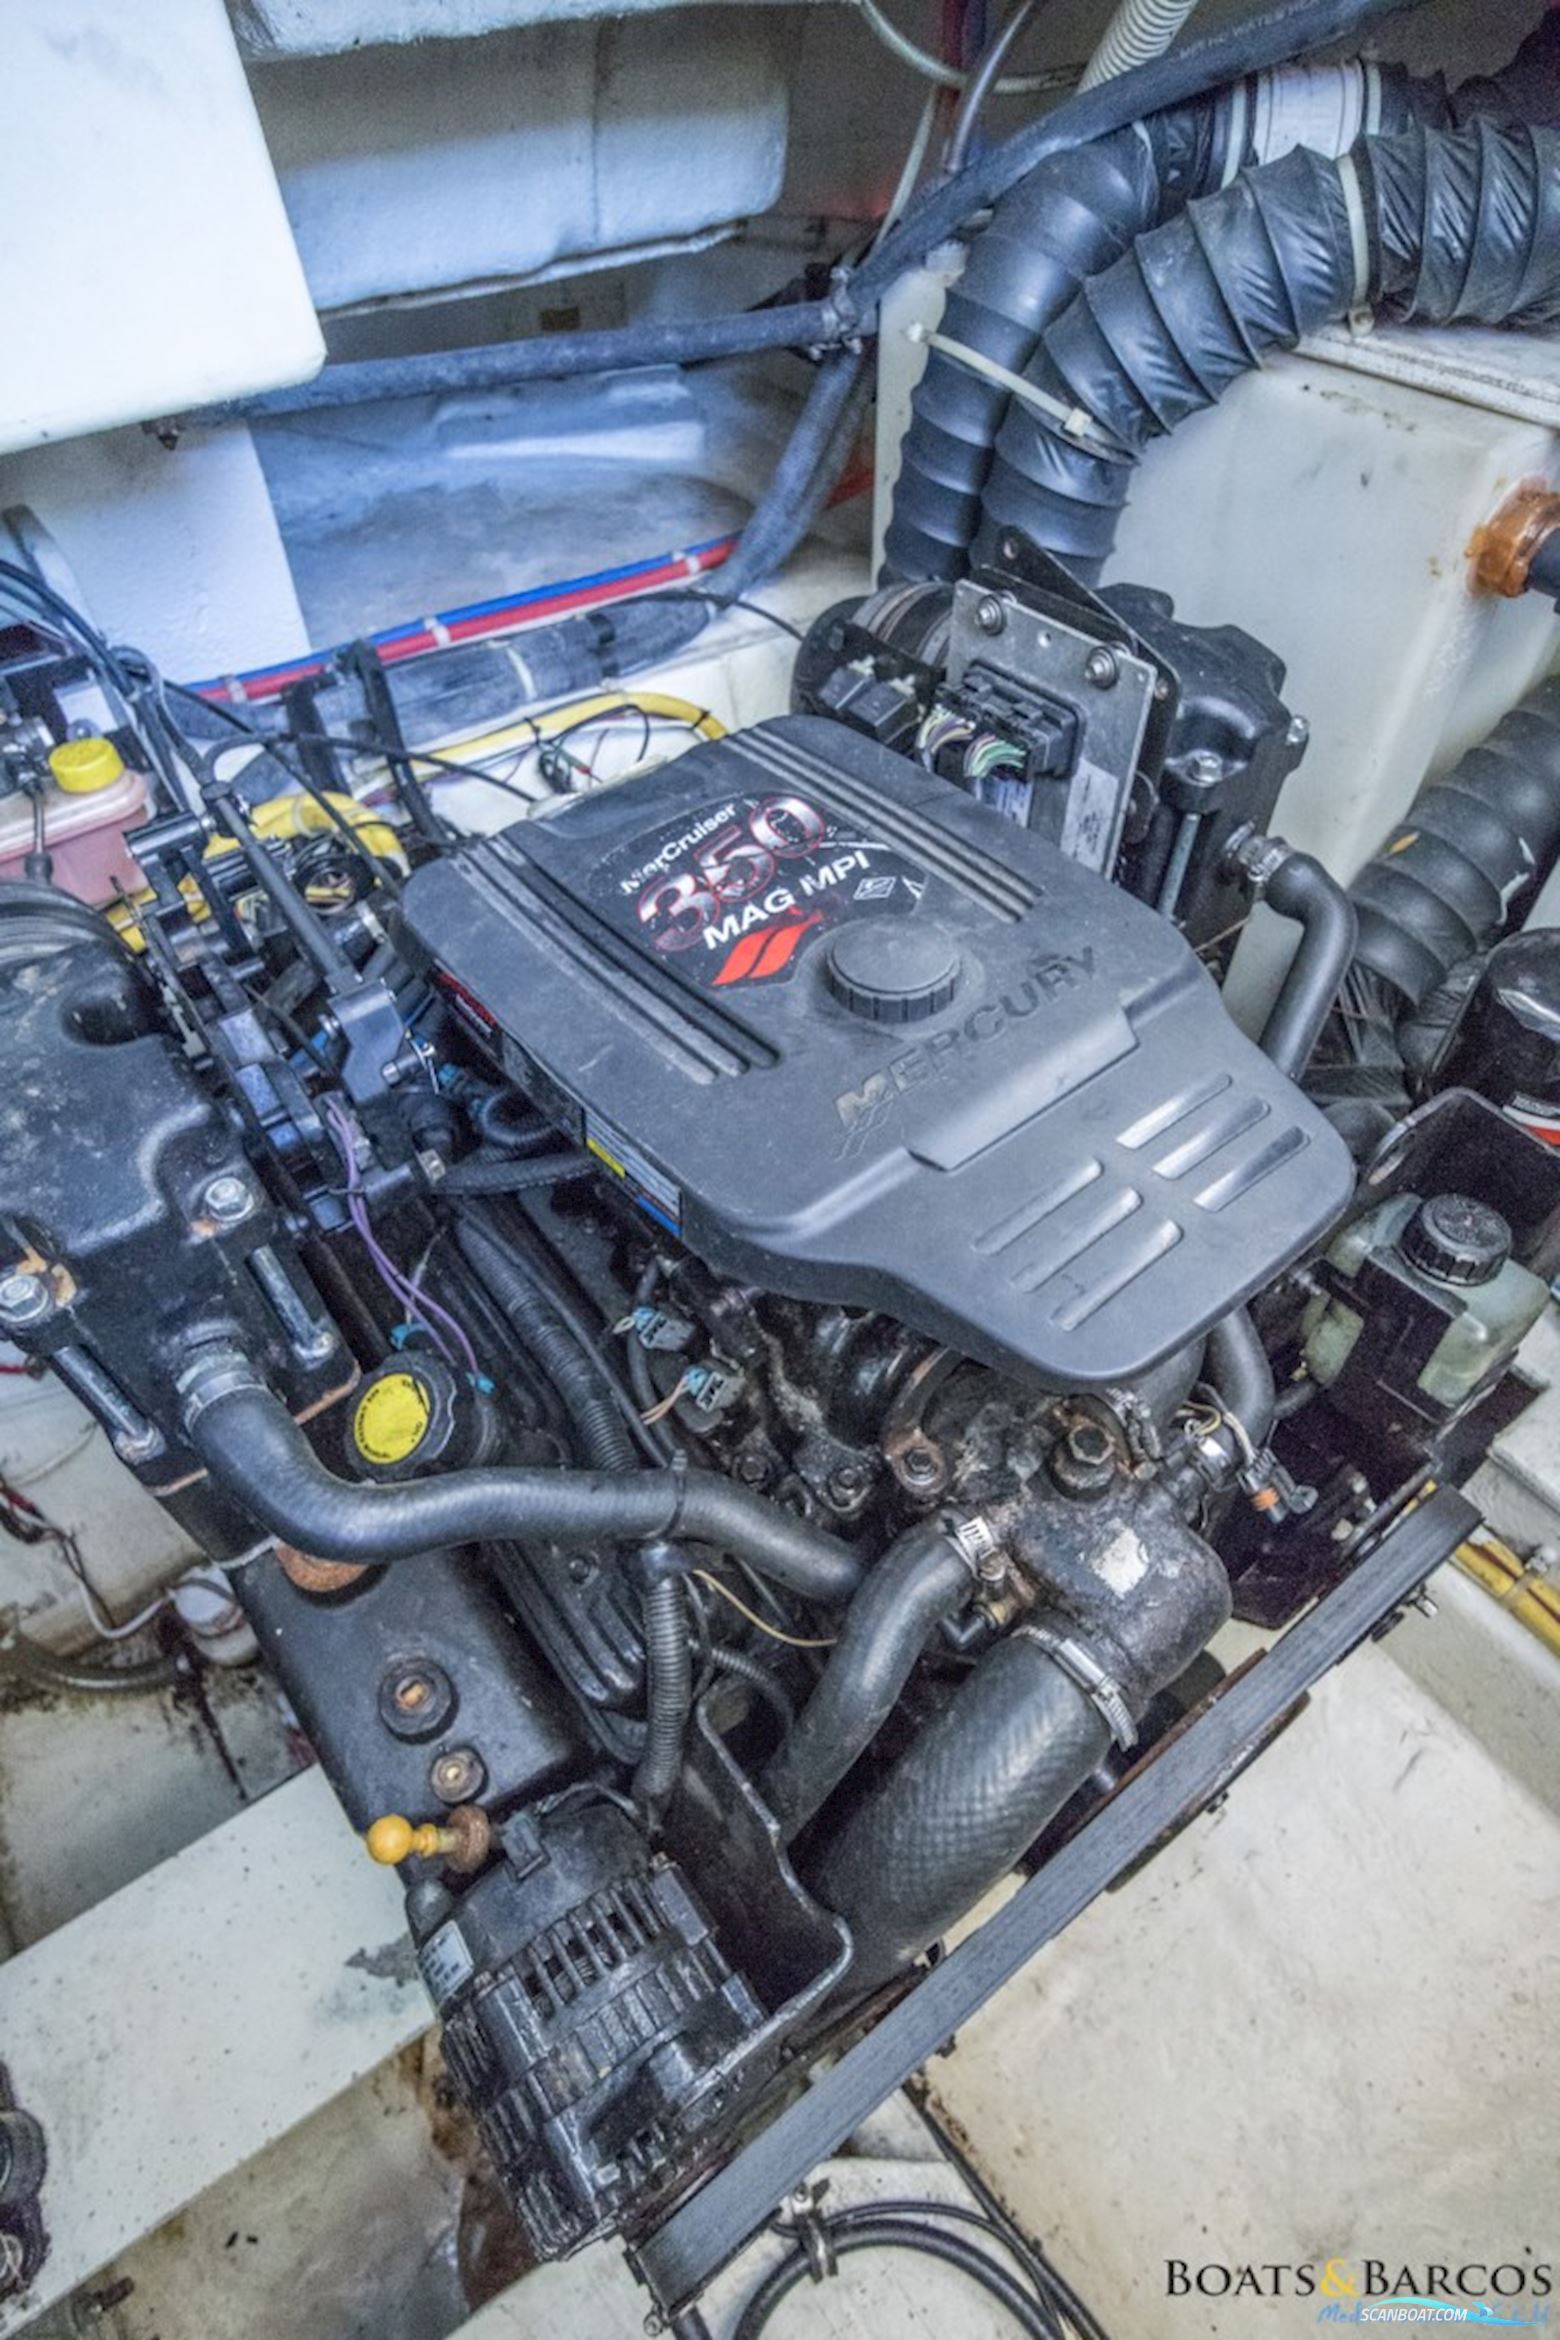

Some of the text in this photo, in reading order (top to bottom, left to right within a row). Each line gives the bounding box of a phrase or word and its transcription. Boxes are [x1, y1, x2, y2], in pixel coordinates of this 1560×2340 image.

[638, 795, 826, 951] 350
[702, 888, 796, 950] MAG
[799, 850, 870, 897] MPI
[834, 945, 1095, 1130] MERCURY
